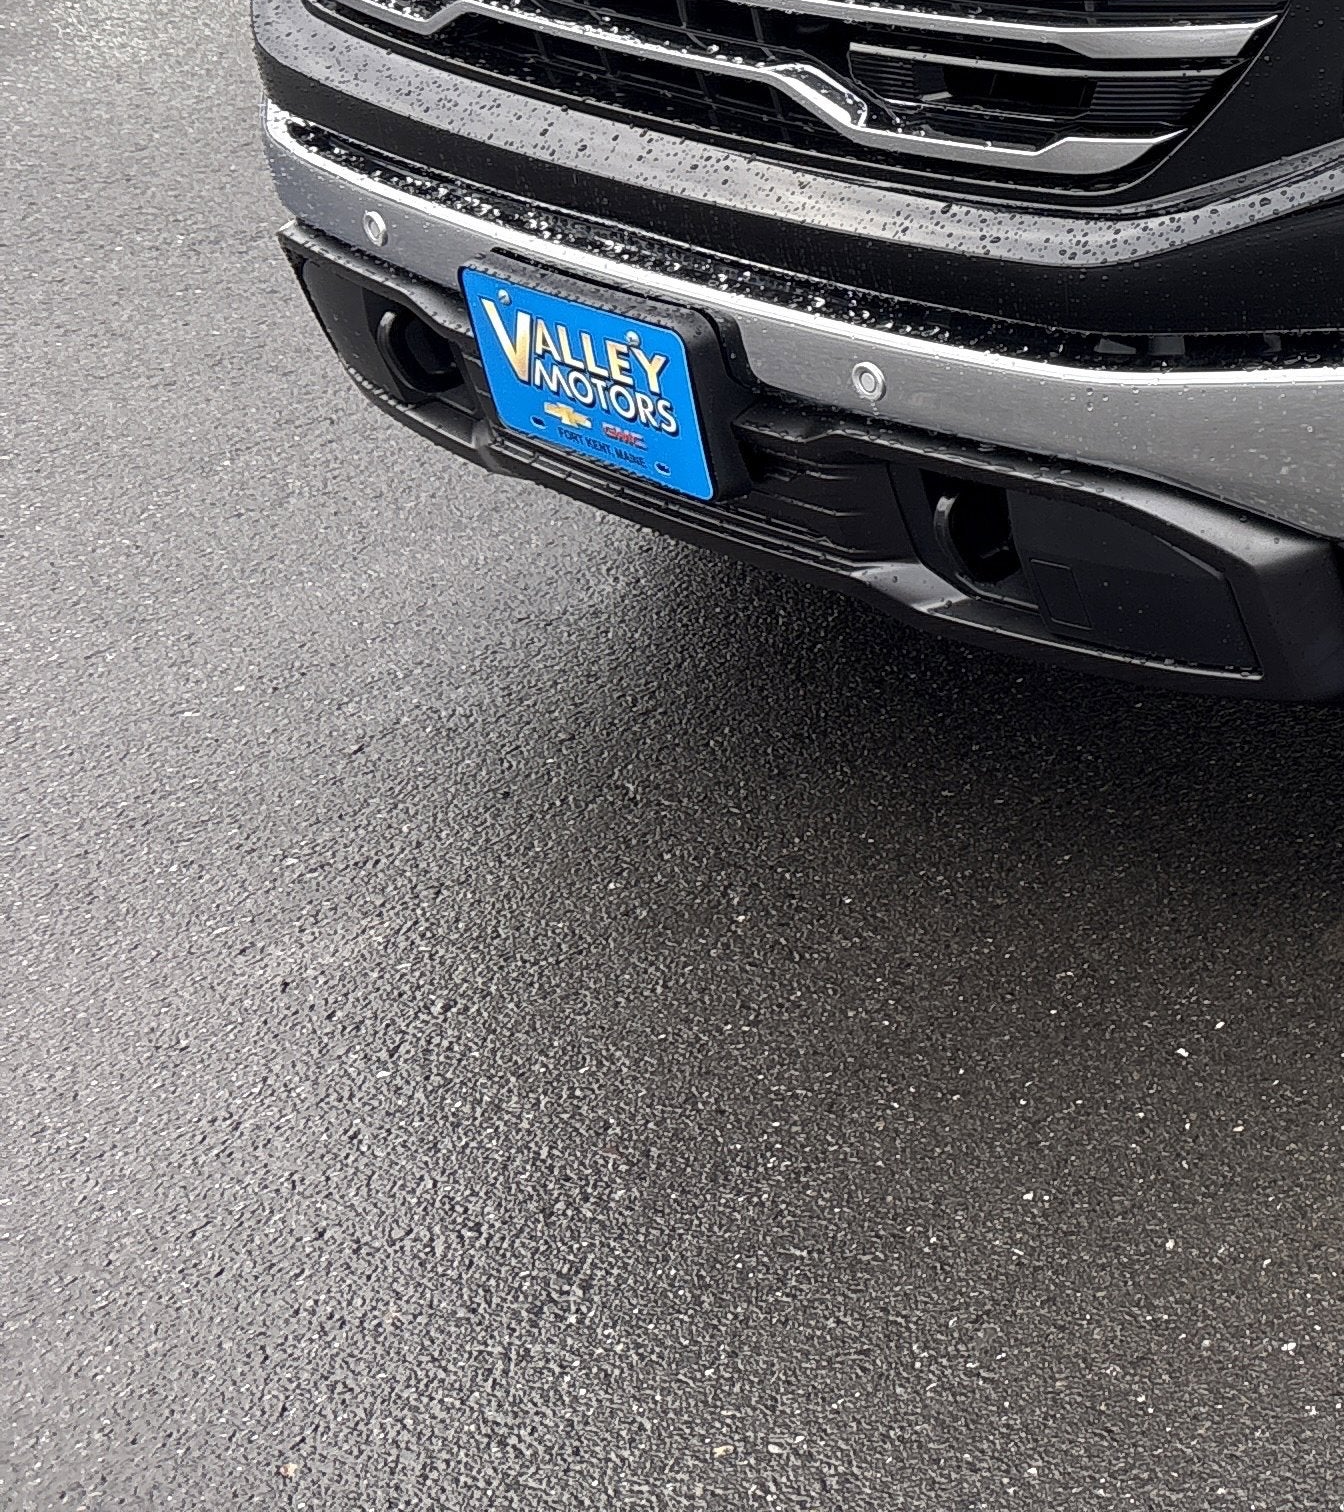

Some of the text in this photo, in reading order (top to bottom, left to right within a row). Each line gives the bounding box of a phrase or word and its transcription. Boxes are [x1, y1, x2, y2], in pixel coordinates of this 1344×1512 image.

[479, 296, 669, 395] VALLEY
[533, 358, 679, 435] MOTORS
[558, 426, 584, 445] FORT
[614, 447, 649, 469] MAINE
